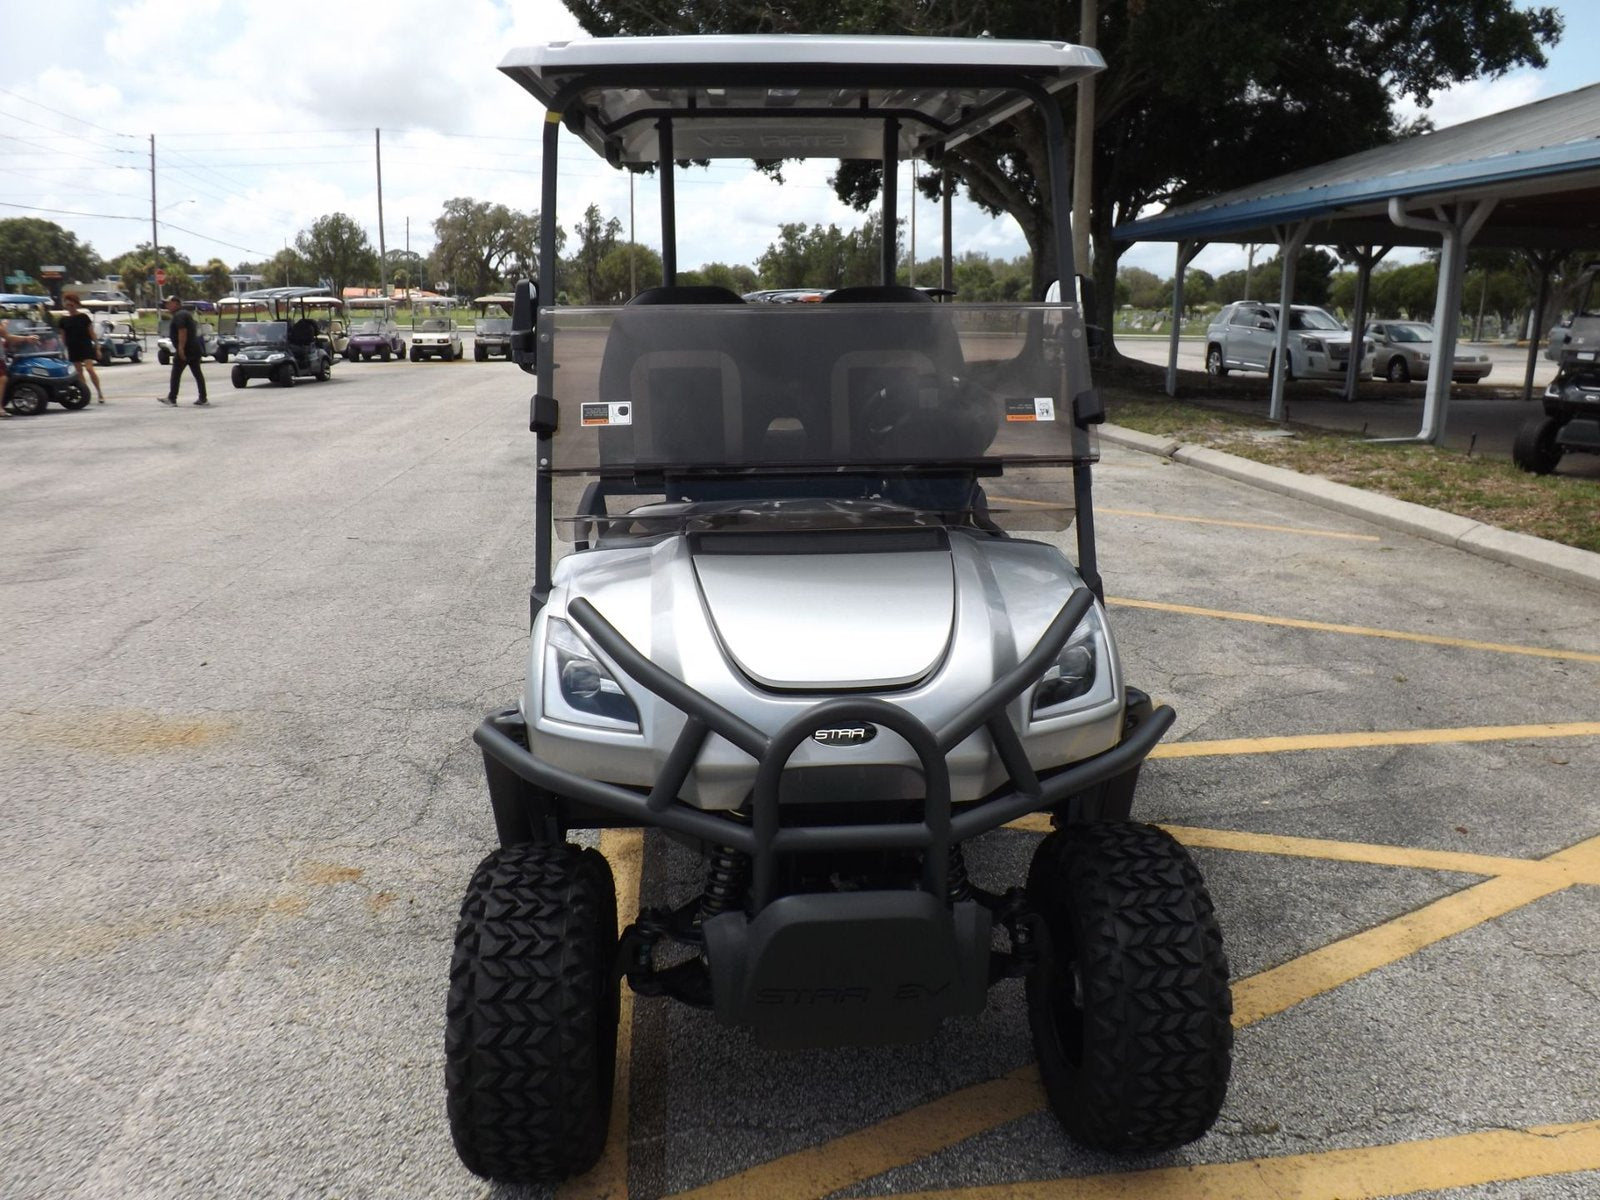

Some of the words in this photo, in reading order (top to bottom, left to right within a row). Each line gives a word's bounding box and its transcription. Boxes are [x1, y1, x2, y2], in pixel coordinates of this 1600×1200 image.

[814, 728, 865, 740] STAR
[755, 987, 872, 1005] STAR
[893, 981, 951, 1000] EV
